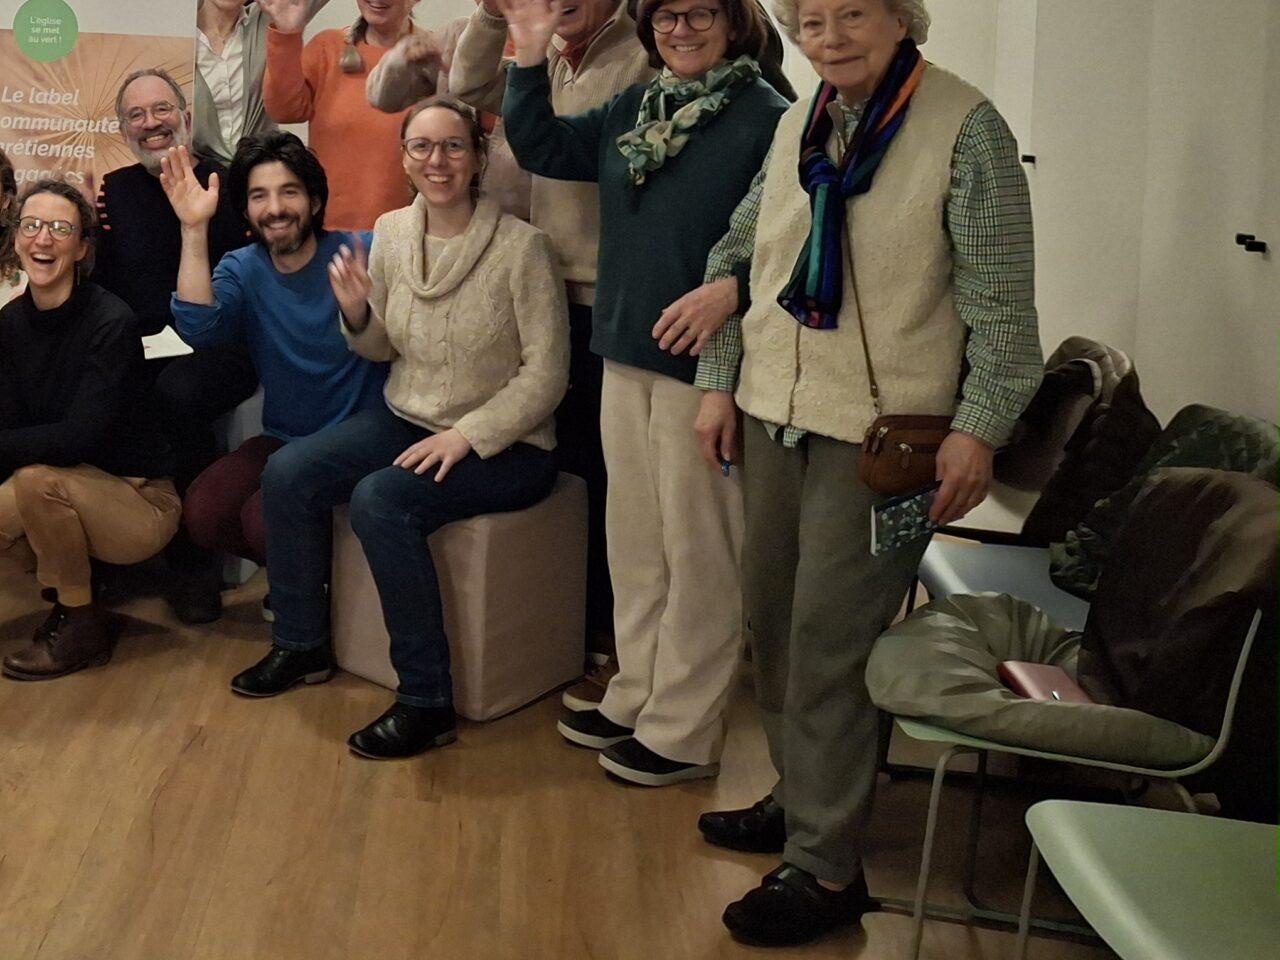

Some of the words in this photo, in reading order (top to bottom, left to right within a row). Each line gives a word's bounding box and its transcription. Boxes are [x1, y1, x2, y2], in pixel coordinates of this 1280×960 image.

[43, 27, 59, 35] met
[1, 86, 24, 103] Le
[29, 87, 80, 105] label
